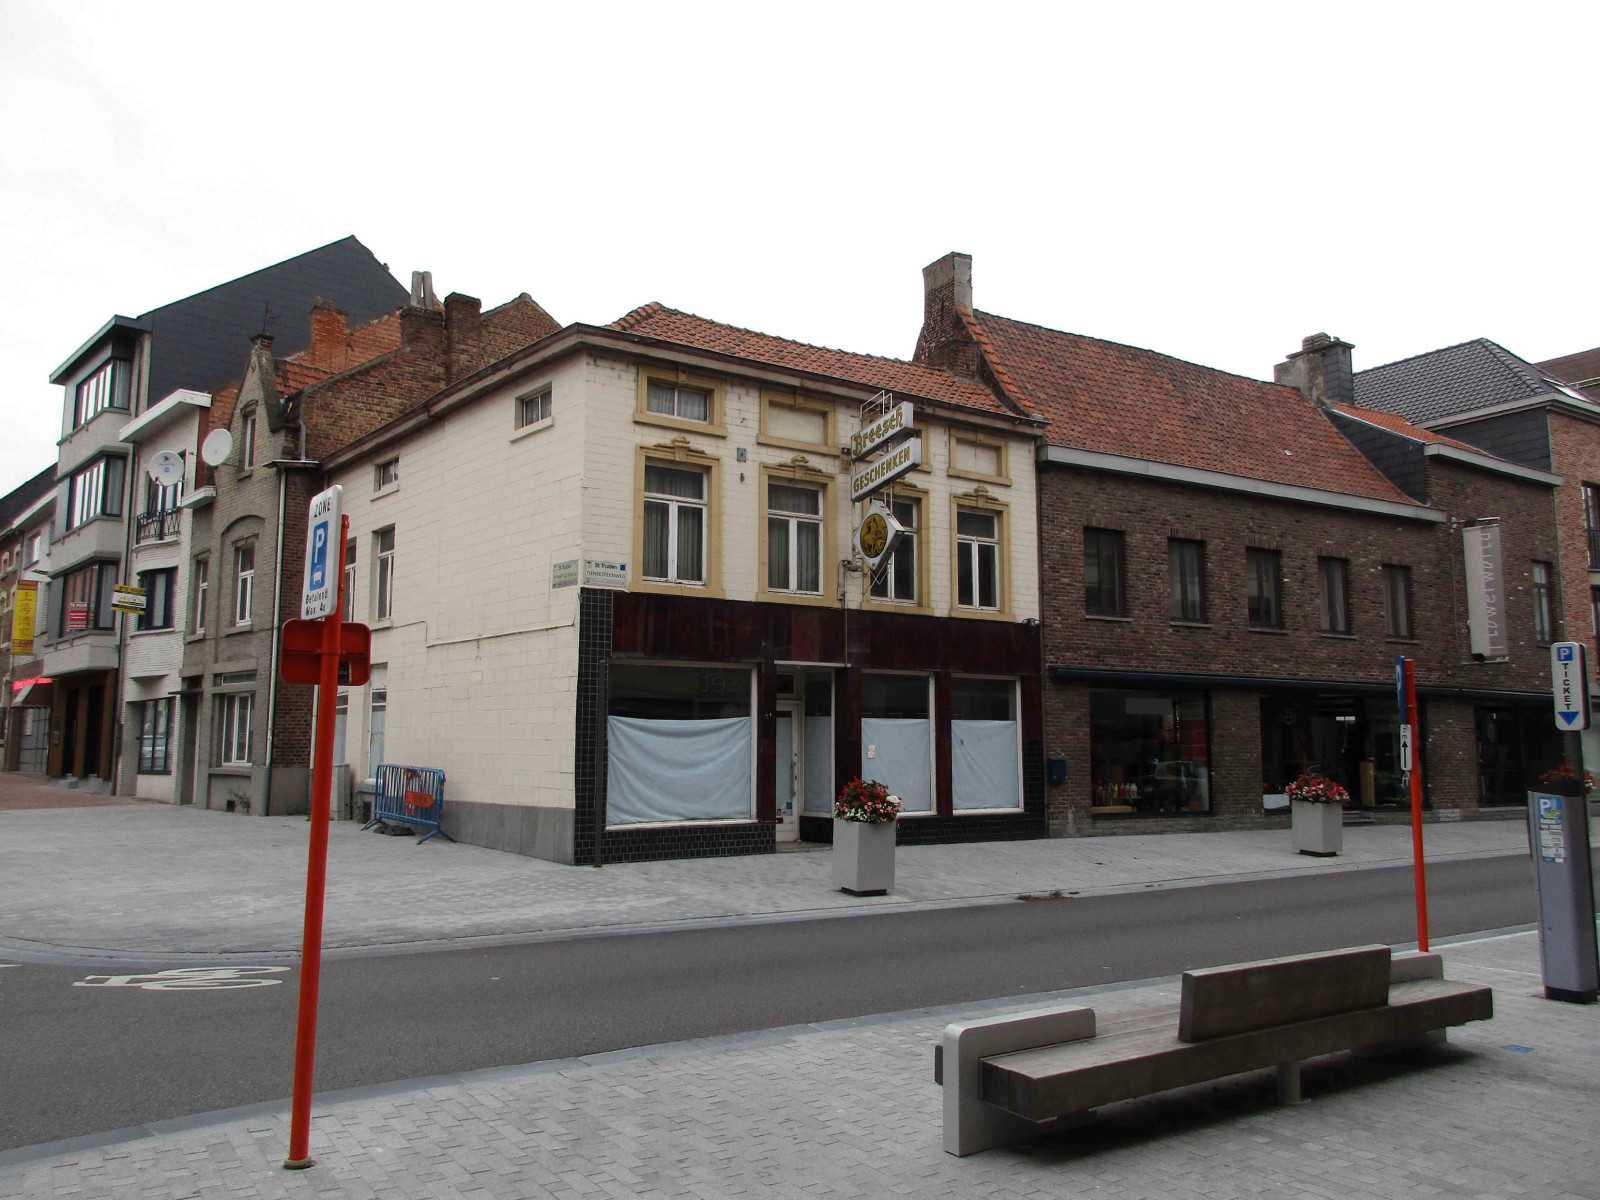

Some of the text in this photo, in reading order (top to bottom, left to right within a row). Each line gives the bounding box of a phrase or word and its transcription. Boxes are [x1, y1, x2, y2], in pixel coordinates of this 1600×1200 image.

[853, 405, 903, 456] Breesch
[853, 445, 911, 493] GESCHENKEN
[313, 498, 331, 518] ZONE
[314, 527, 325, 563] P
[305, 589, 328, 604] Betalend
[1560, 648, 1570, 660] P
[1562, 663, 1571, 710] TICKET
